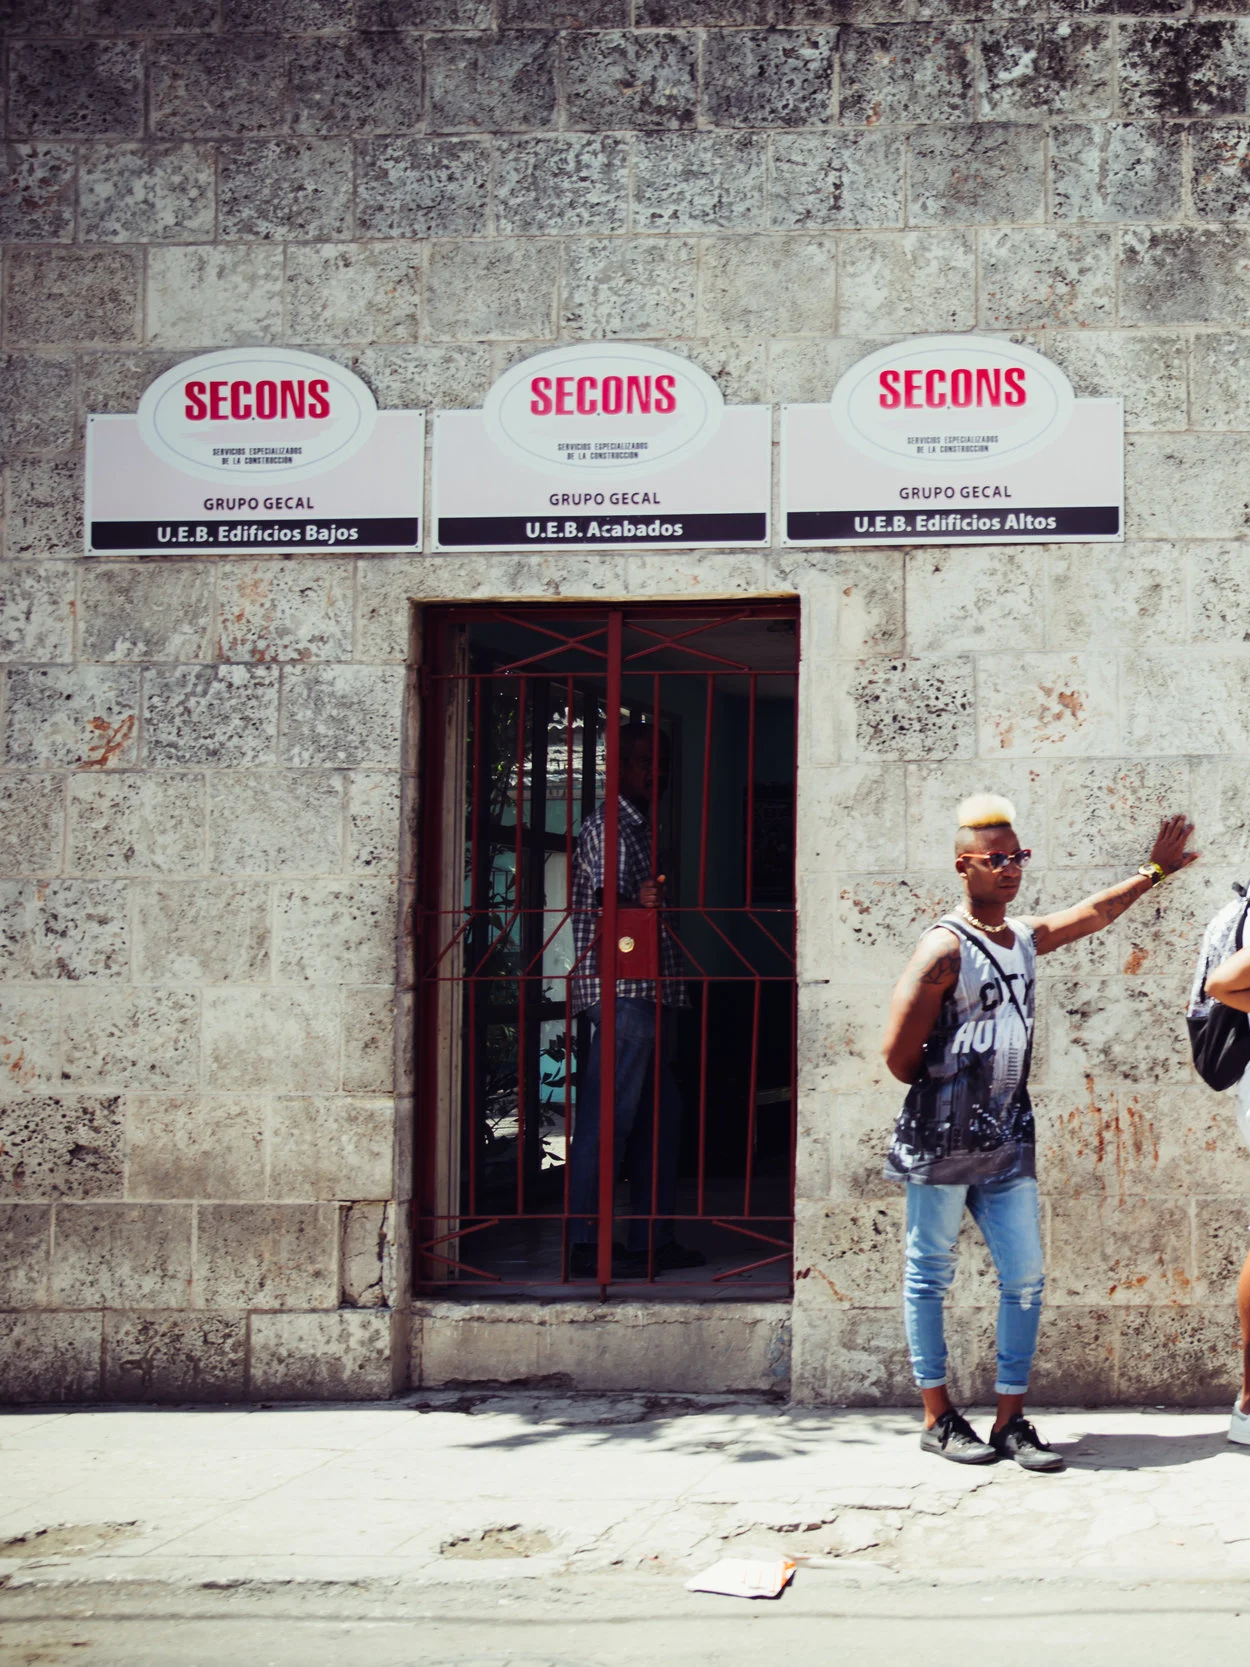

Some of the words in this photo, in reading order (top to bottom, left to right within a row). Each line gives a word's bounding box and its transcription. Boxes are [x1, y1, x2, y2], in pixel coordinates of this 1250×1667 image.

[530, 374, 677, 416] SECONS
[879, 367, 1027, 409] SECONS
[184, 379, 331, 421] SECONS
[558, 443, 591, 451] SERVICIOS
[594, 442, 648, 450] ESPECIALIZADOS
[907, 436, 941, 444] SERVICIOS
[944, 435, 999, 444] ESPECIALIZADOS
[212, 448, 246, 456] SERVICIOS
[249, 447, 302, 455] ESPECIALIZADOS
[567, 452, 575, 460] DE
[578, 452, 586, 460] LA
[916, 445, 924, 454] DE
[928, 445, 936, 453] LA
[221, 457, 229, 465] DE
[233, 457, 241, 465] LA
[549, 493, 605, 506] GRUPO
[609, 492, 661, 505] GECAL
[899, 486, 955, 500] GRUPO
[960, 485, 1012, 499] GECAL
[203, 498, 259, 510] GRUPO
[263, 497, 315, 510] GECAL
[525, 521, 583, 538] U.E.B.
[586, 520, 684, 537] Acabados
[854, 515, 912, 532] U.E.B.
[915, 514, 1001, 531] Edificios
[1004, 513, 1057, 530] Altos
[157, 526, 214, 542] U.E.B.
[218, 525, 301, 541] Edificios
[305, 524, 359, 544] Bajos
